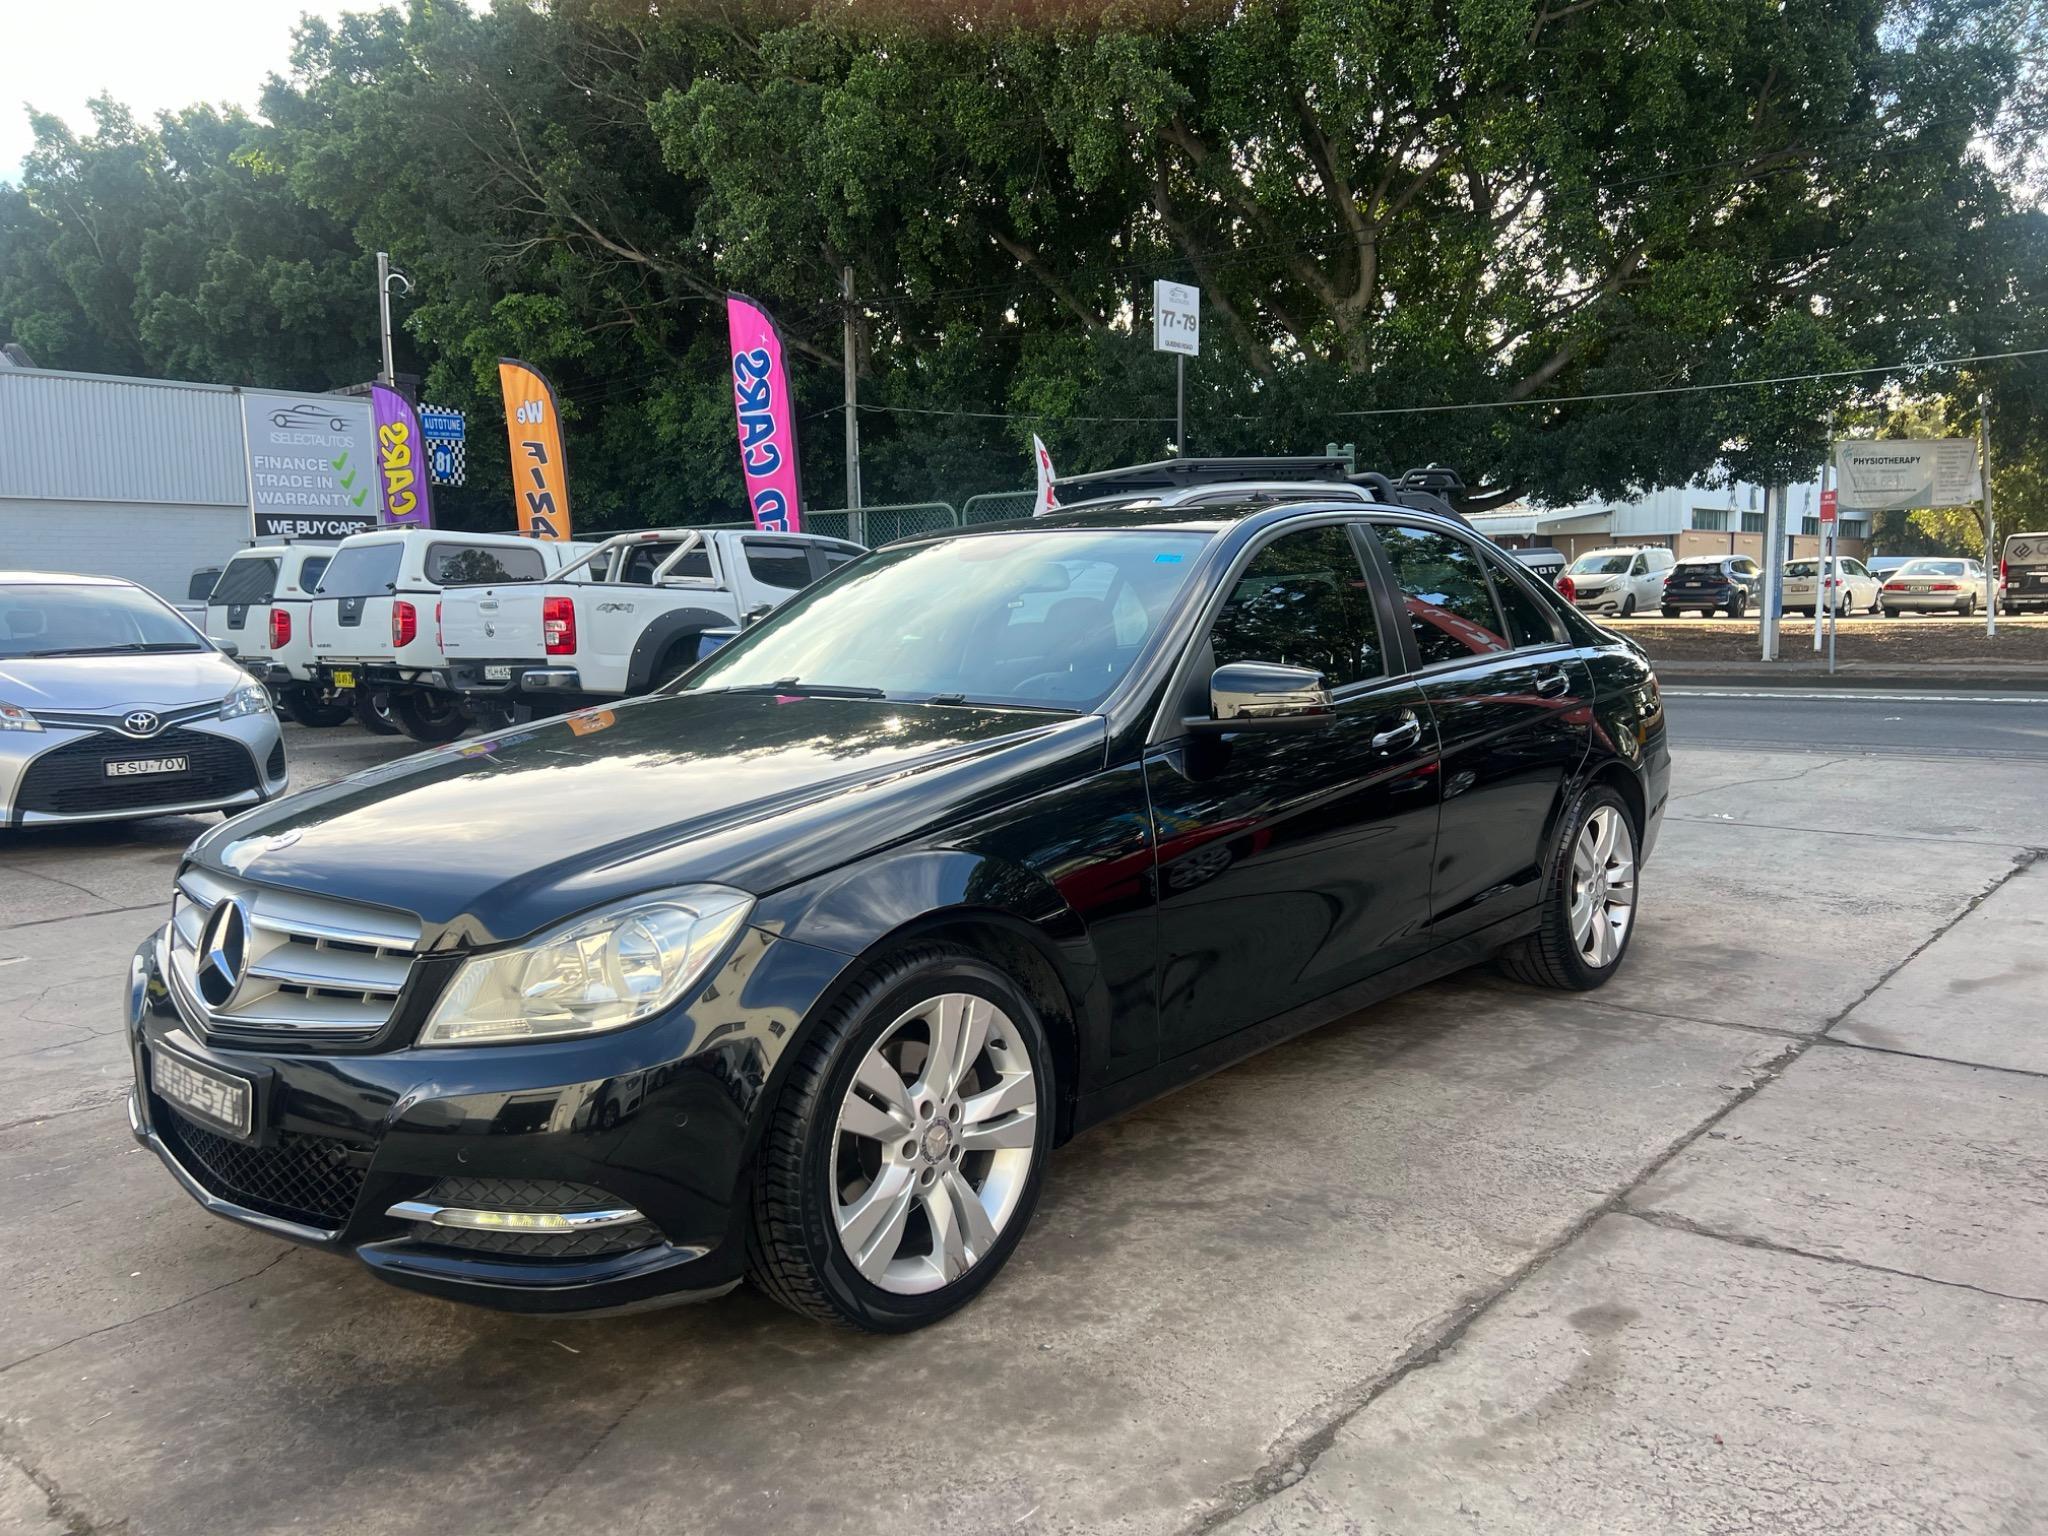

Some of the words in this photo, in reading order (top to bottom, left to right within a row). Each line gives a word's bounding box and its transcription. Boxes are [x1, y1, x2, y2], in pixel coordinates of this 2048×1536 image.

[424, 417, 462, 430] AUTOTUNE
[254, 455, 329, 472] FINANCE
[436, 451, 451, 473] 81
[1853, 456, 1921, 465] PHYSIOTHERAPY
[256, 473, 313, 489] TRADE
[317, 476, 333, 490] IN
[258, 491, 351, 507] WARRANTY
[267, 520, 296, 535] WE
[299, 520, 327, 535] BUY
